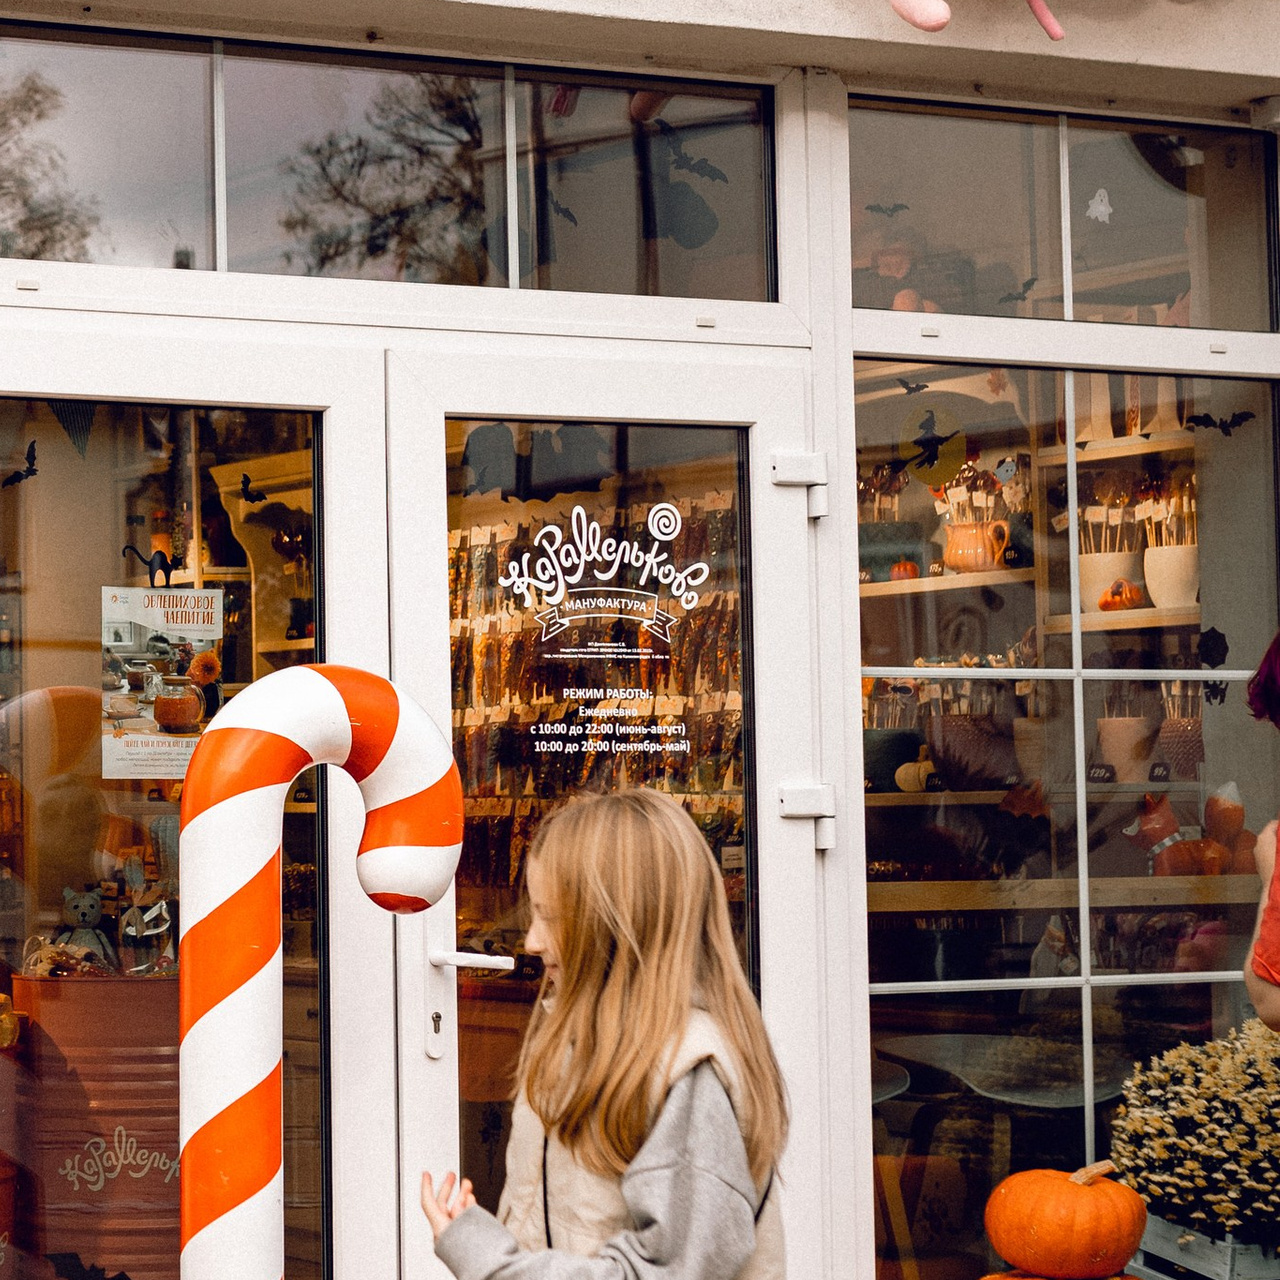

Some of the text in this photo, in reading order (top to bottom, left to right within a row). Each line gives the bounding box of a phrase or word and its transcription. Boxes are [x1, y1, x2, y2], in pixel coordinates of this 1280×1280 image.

[143, 594, 216, 609] ОБЛЕПИХОВОЕ
[565, 598, 647, 612] МАНУФАКТУРА
[164, 610, 216, 625] ЧАЕПИТИЕ
[563, 688, 654, 699] РЕЖИМ РАБОТЫ:
[578, 706, 638, 718] Ежедневно
[530, 723, 686, 736] с 10:00 до 22:00 (июнь-август)
[534, 740, 691, 753] 10:00 до 20:00 (сентябрь-май)
